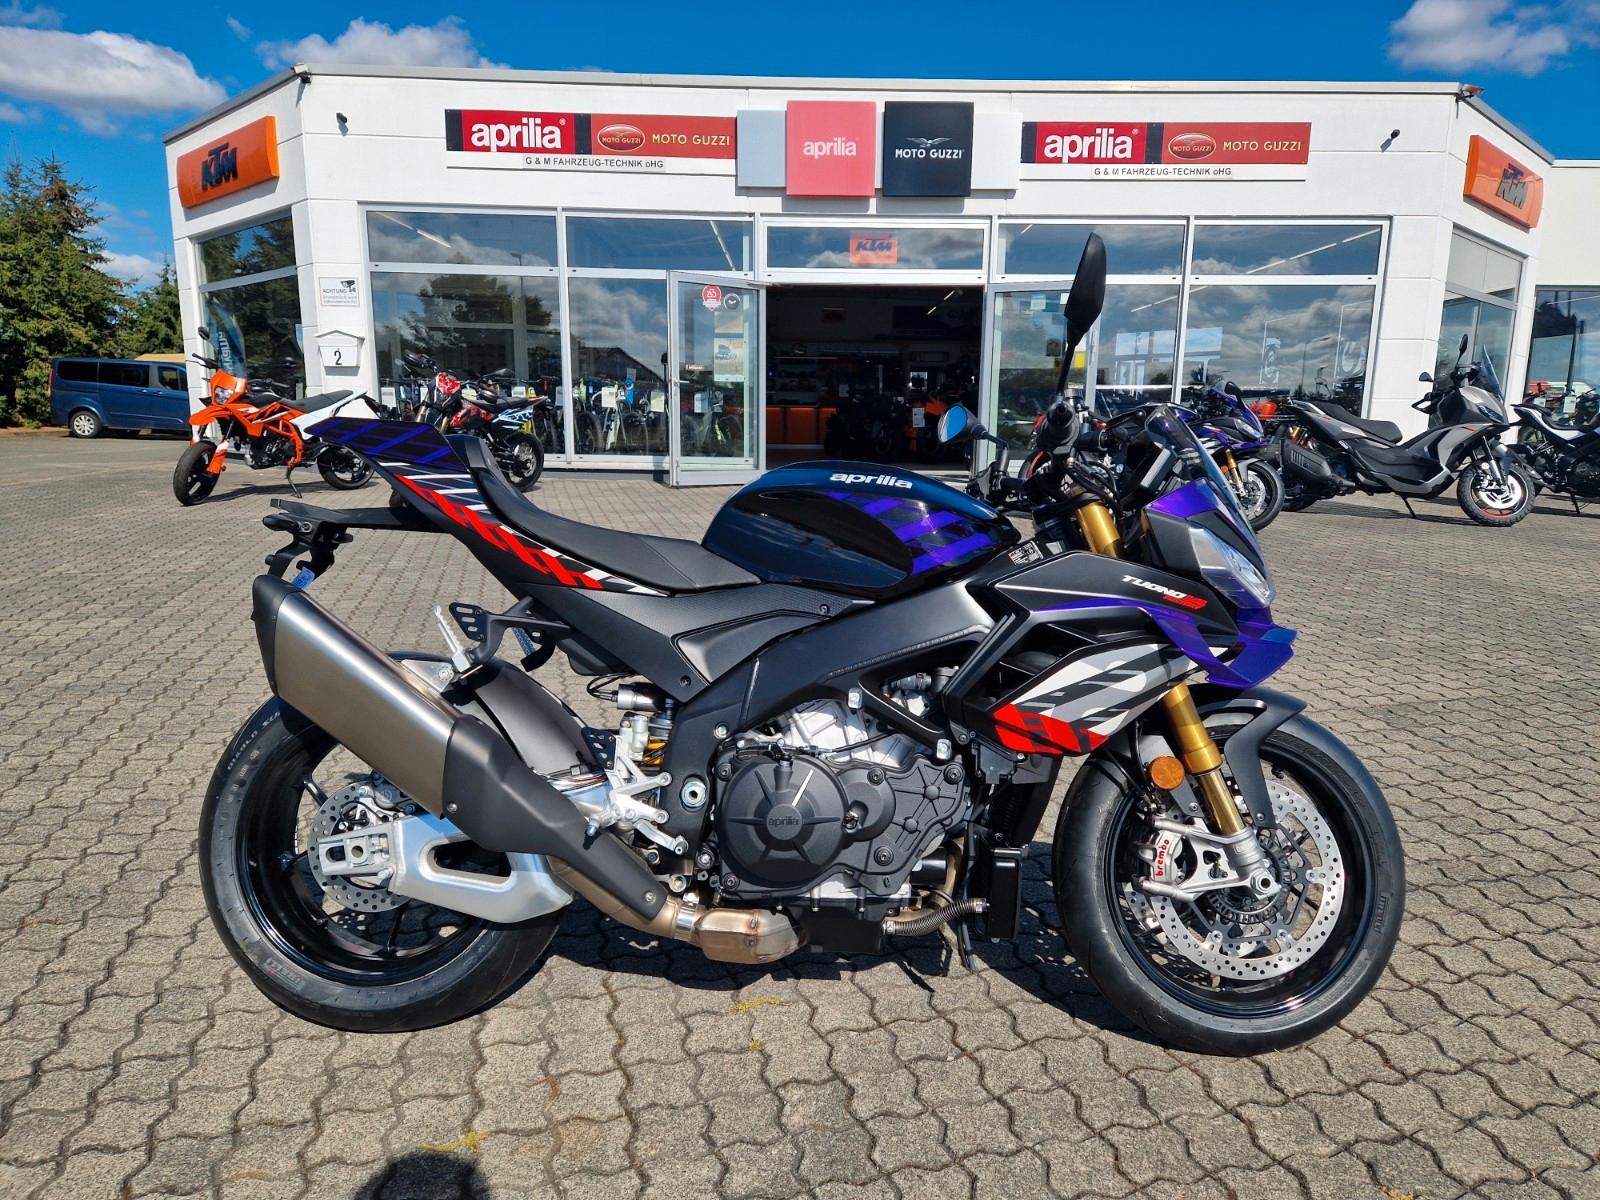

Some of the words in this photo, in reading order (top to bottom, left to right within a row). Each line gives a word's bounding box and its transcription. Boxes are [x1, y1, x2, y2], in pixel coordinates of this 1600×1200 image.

[470, 117, 562, 152] aprilia
[652, 133, 687, 145] MOTO
[692, 134, 730, 146] GUZZI
[803, 137, 857, 159] aprilia
[1044, 127, 1133, 164] aprilia
[1223, 141, 1259, 151] MOTO
[1263, 141, 1301, 151] GUZZI
[895, 149, 926, 159] MOTO
[929, 149, 962, 159] GUZZI
[201, 142, 238, 191] KTM
[525, 157, 532, 165] G
[535, 157, 541, 165] &
[553, 158, 643, 168] FAHRZEUG-TECHNIK
[645, 160, 664, 168] oHG
[1094, 167, 1101, 176] G
[1121, 168, 1211, 176] FAHRZEUG-TECHNIK
[1213, 168, 1232, 176] oHG
[1495, 162, 1529, 210] KTM
[856, 239, 893, 251] KTM
[333, 350, 342, 365] 2
[829, 473, 913, 489] aprilia
[1121, 574, 1187, 599] TUONO
[768, 815, 799, 828] aprilia
[1155, 839, 1170, 877] brembo
